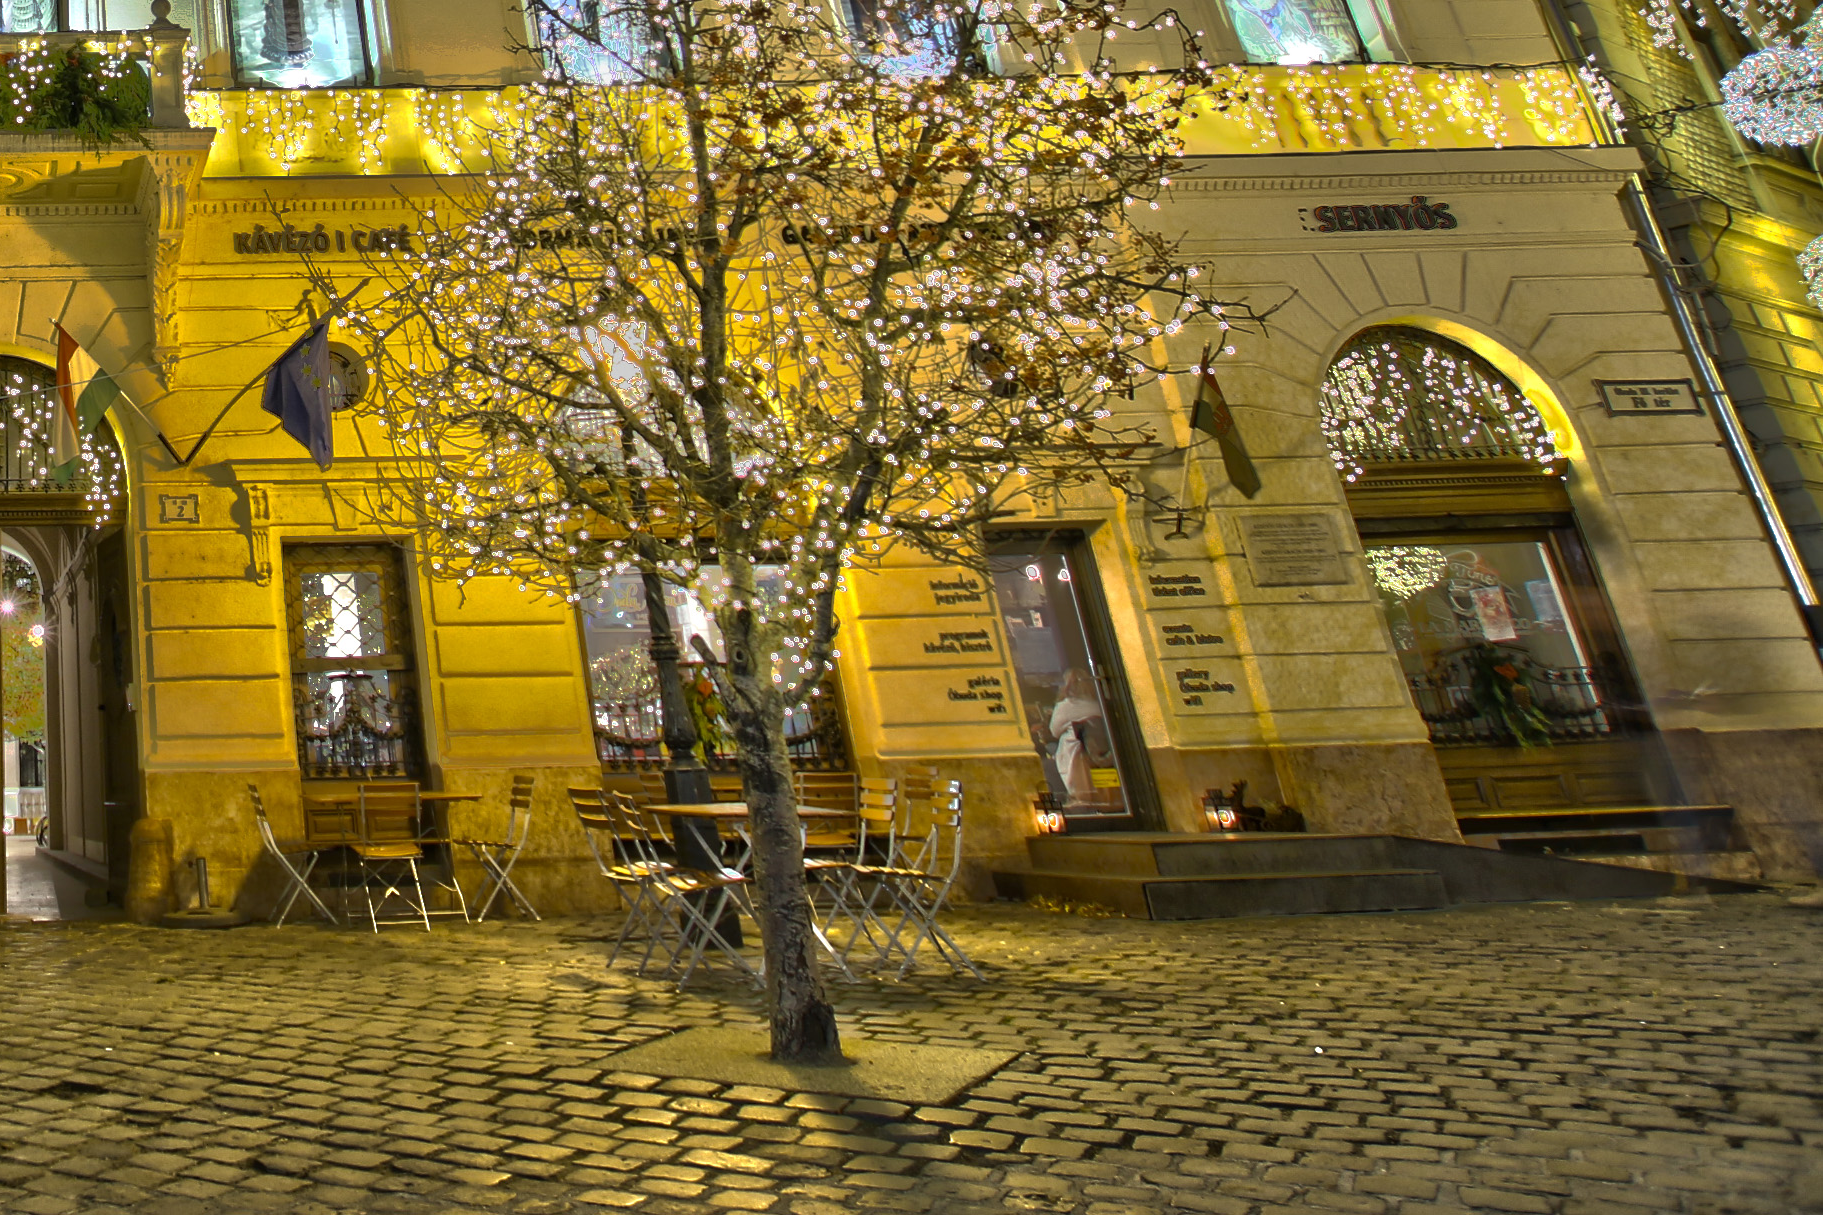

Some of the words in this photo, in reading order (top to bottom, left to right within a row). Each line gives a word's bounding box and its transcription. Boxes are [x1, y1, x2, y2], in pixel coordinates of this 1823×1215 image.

[1314, 196, 1458, 232] SERNYŐS
[233, 224, 330, 254] KÁVÉZÓ
[351, 223, 411, 253] CAFÉ
[1653, 396, 1671, 408] tér
[176, 505, 186, 518] 2
